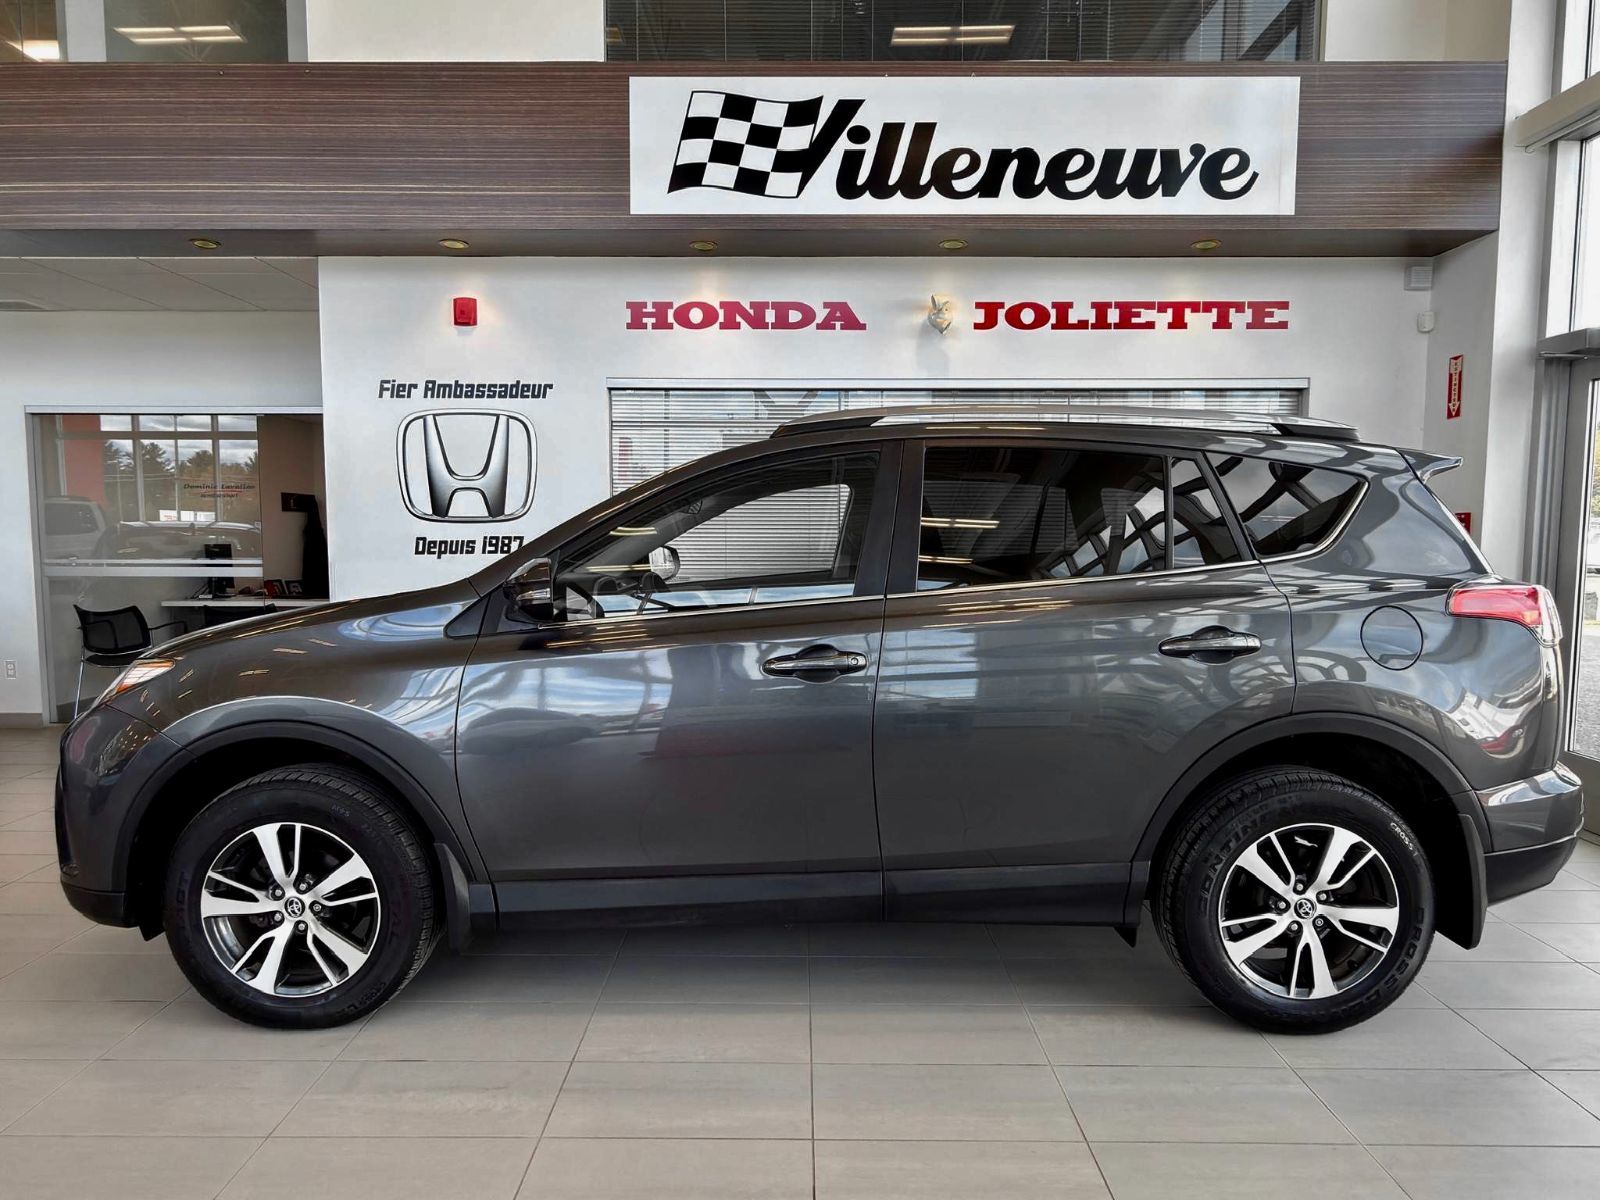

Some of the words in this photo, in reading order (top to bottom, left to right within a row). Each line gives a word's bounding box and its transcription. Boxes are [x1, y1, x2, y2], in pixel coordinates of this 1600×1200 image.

[796, 97, 1260, 201] Villeneuve
[626, 301, 867, 331] HONDA
[973, 301, 1290, 330] JOLIETTE
[378, 379, 418, 399] Fier
[423, 379, 553, 399] Ambassadeur
[415, 536, 476, 559] Depuis
[482, 536, 524, 554] 1987
